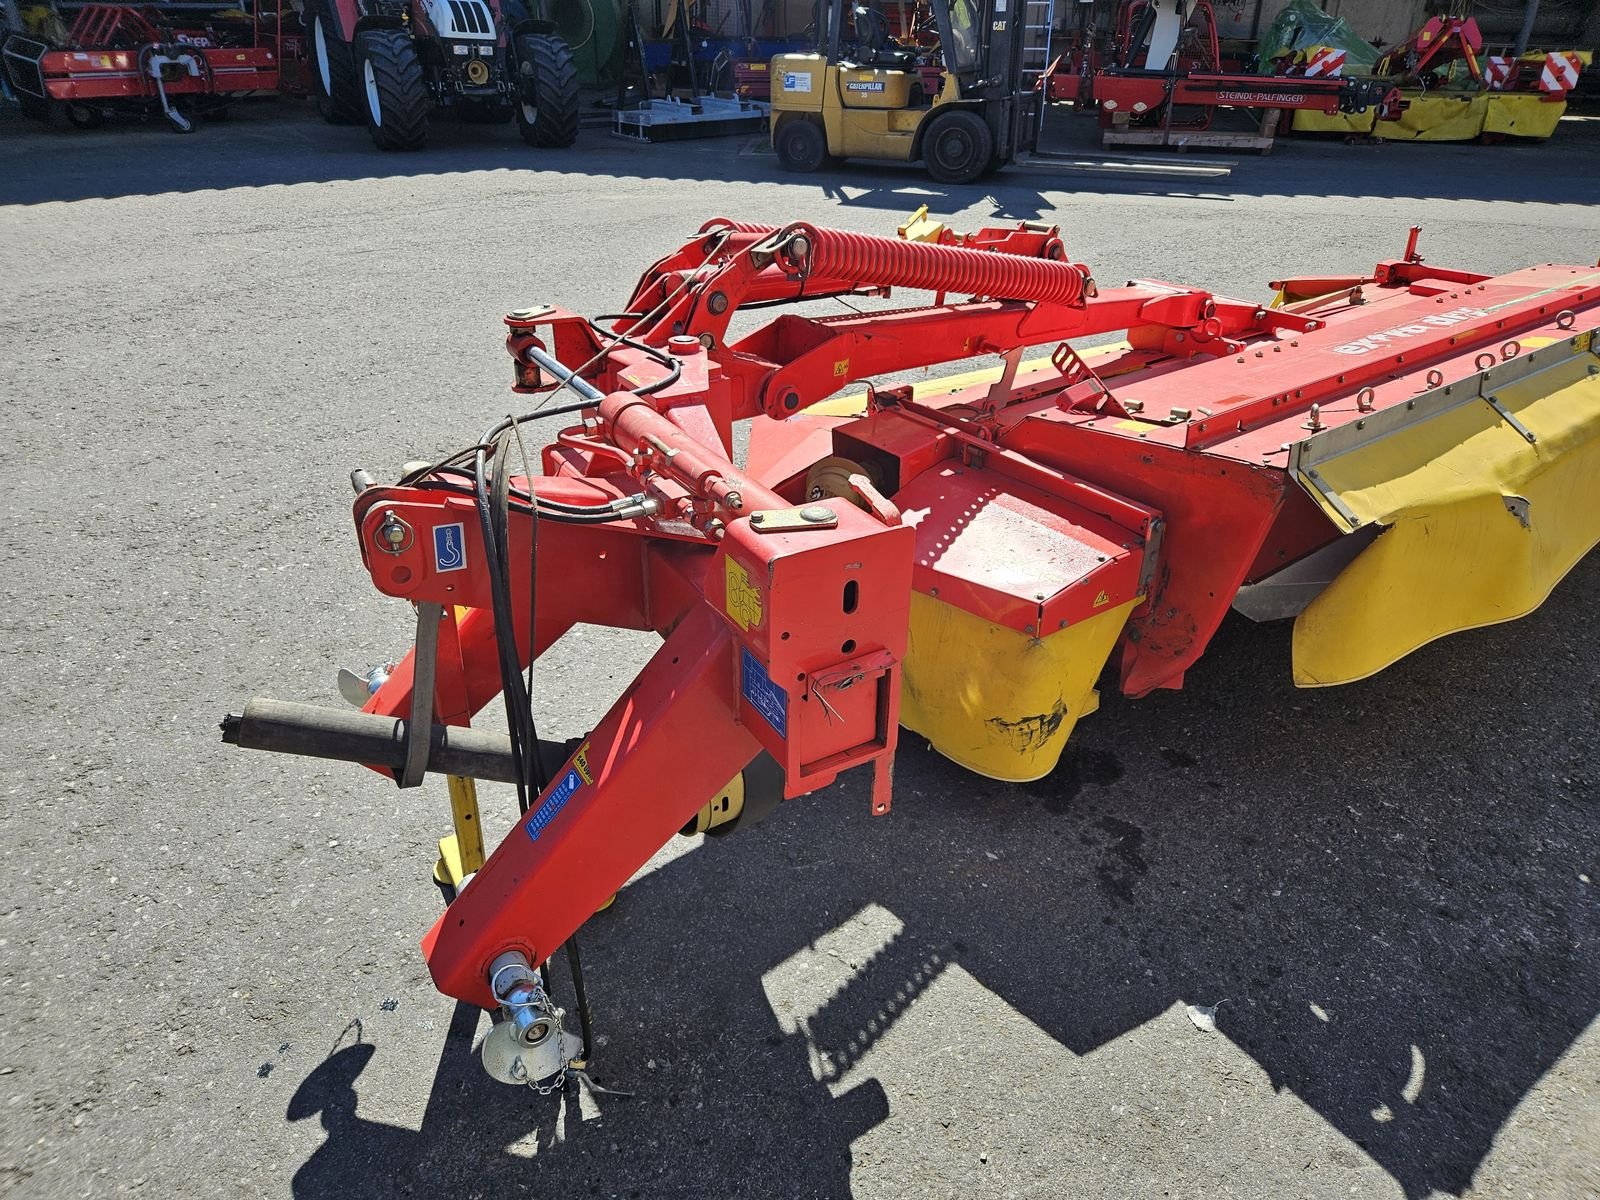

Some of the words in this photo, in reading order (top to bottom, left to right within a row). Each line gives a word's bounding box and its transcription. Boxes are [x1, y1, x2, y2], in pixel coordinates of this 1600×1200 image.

[992, 20, 1007, 31] CAT
[848, 81, 883, 91] CATERPILLAR
[1219, 91, 1304, 103] STEINDL-PALFINGER
[1333, 323, 1430, 355] extra
